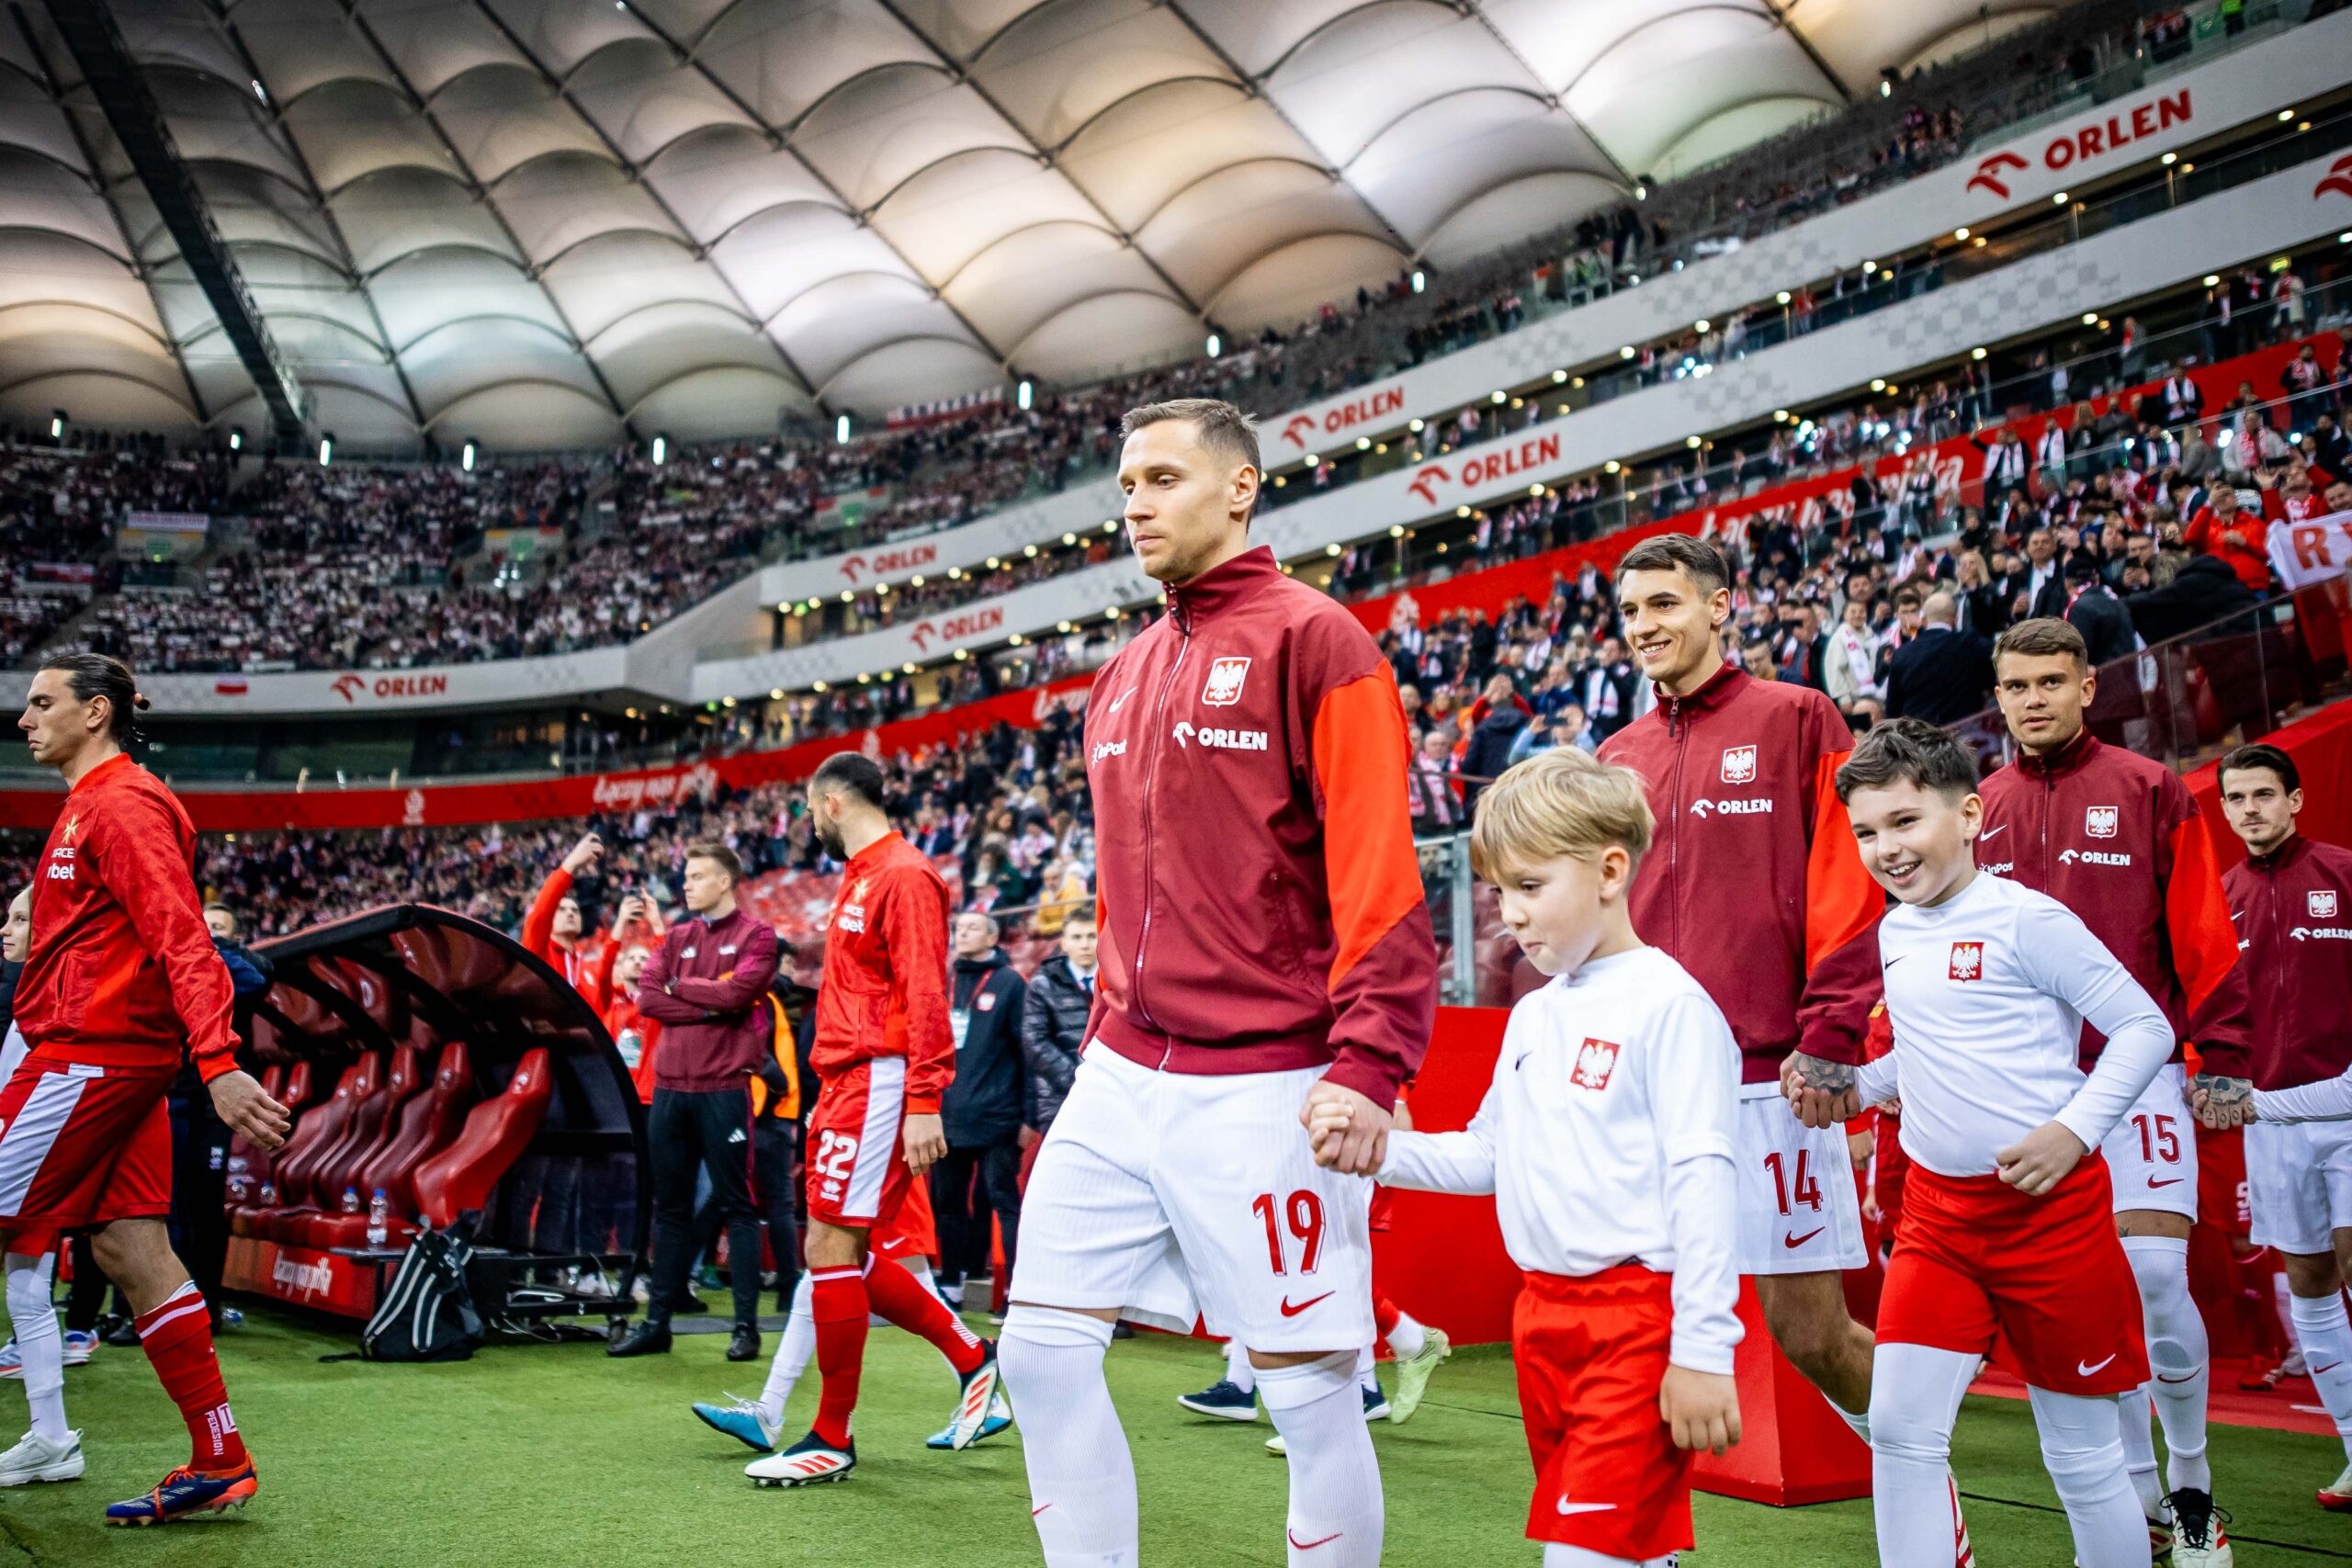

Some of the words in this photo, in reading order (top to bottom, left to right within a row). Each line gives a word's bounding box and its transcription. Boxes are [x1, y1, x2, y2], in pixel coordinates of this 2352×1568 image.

[2044, 89, 2193, 171] ORLEN
[1325, 387, 1403, 433] ORLEN
[1461, 434, 1559, 487] ORLEN
[874, 546, 936, 574] ORLEN
[944, 608, 1003, 641] ORLEN
[374, 675, 447, 697] ORLEN
[1198, 728, 1268, 750] ORLEN
[1717, 798, 1772, 815] ORLEN
[1988, 862, 2014, 874] InPos
[2080, 851, 2131, 866] ORLEN
[816, 1129, 858, 1180] 22
[2132, 1113, 2181, 1166] 15
[1764, 1148, 1823, 1216] 14
[1252, 1190, 1327, 1277] 19
